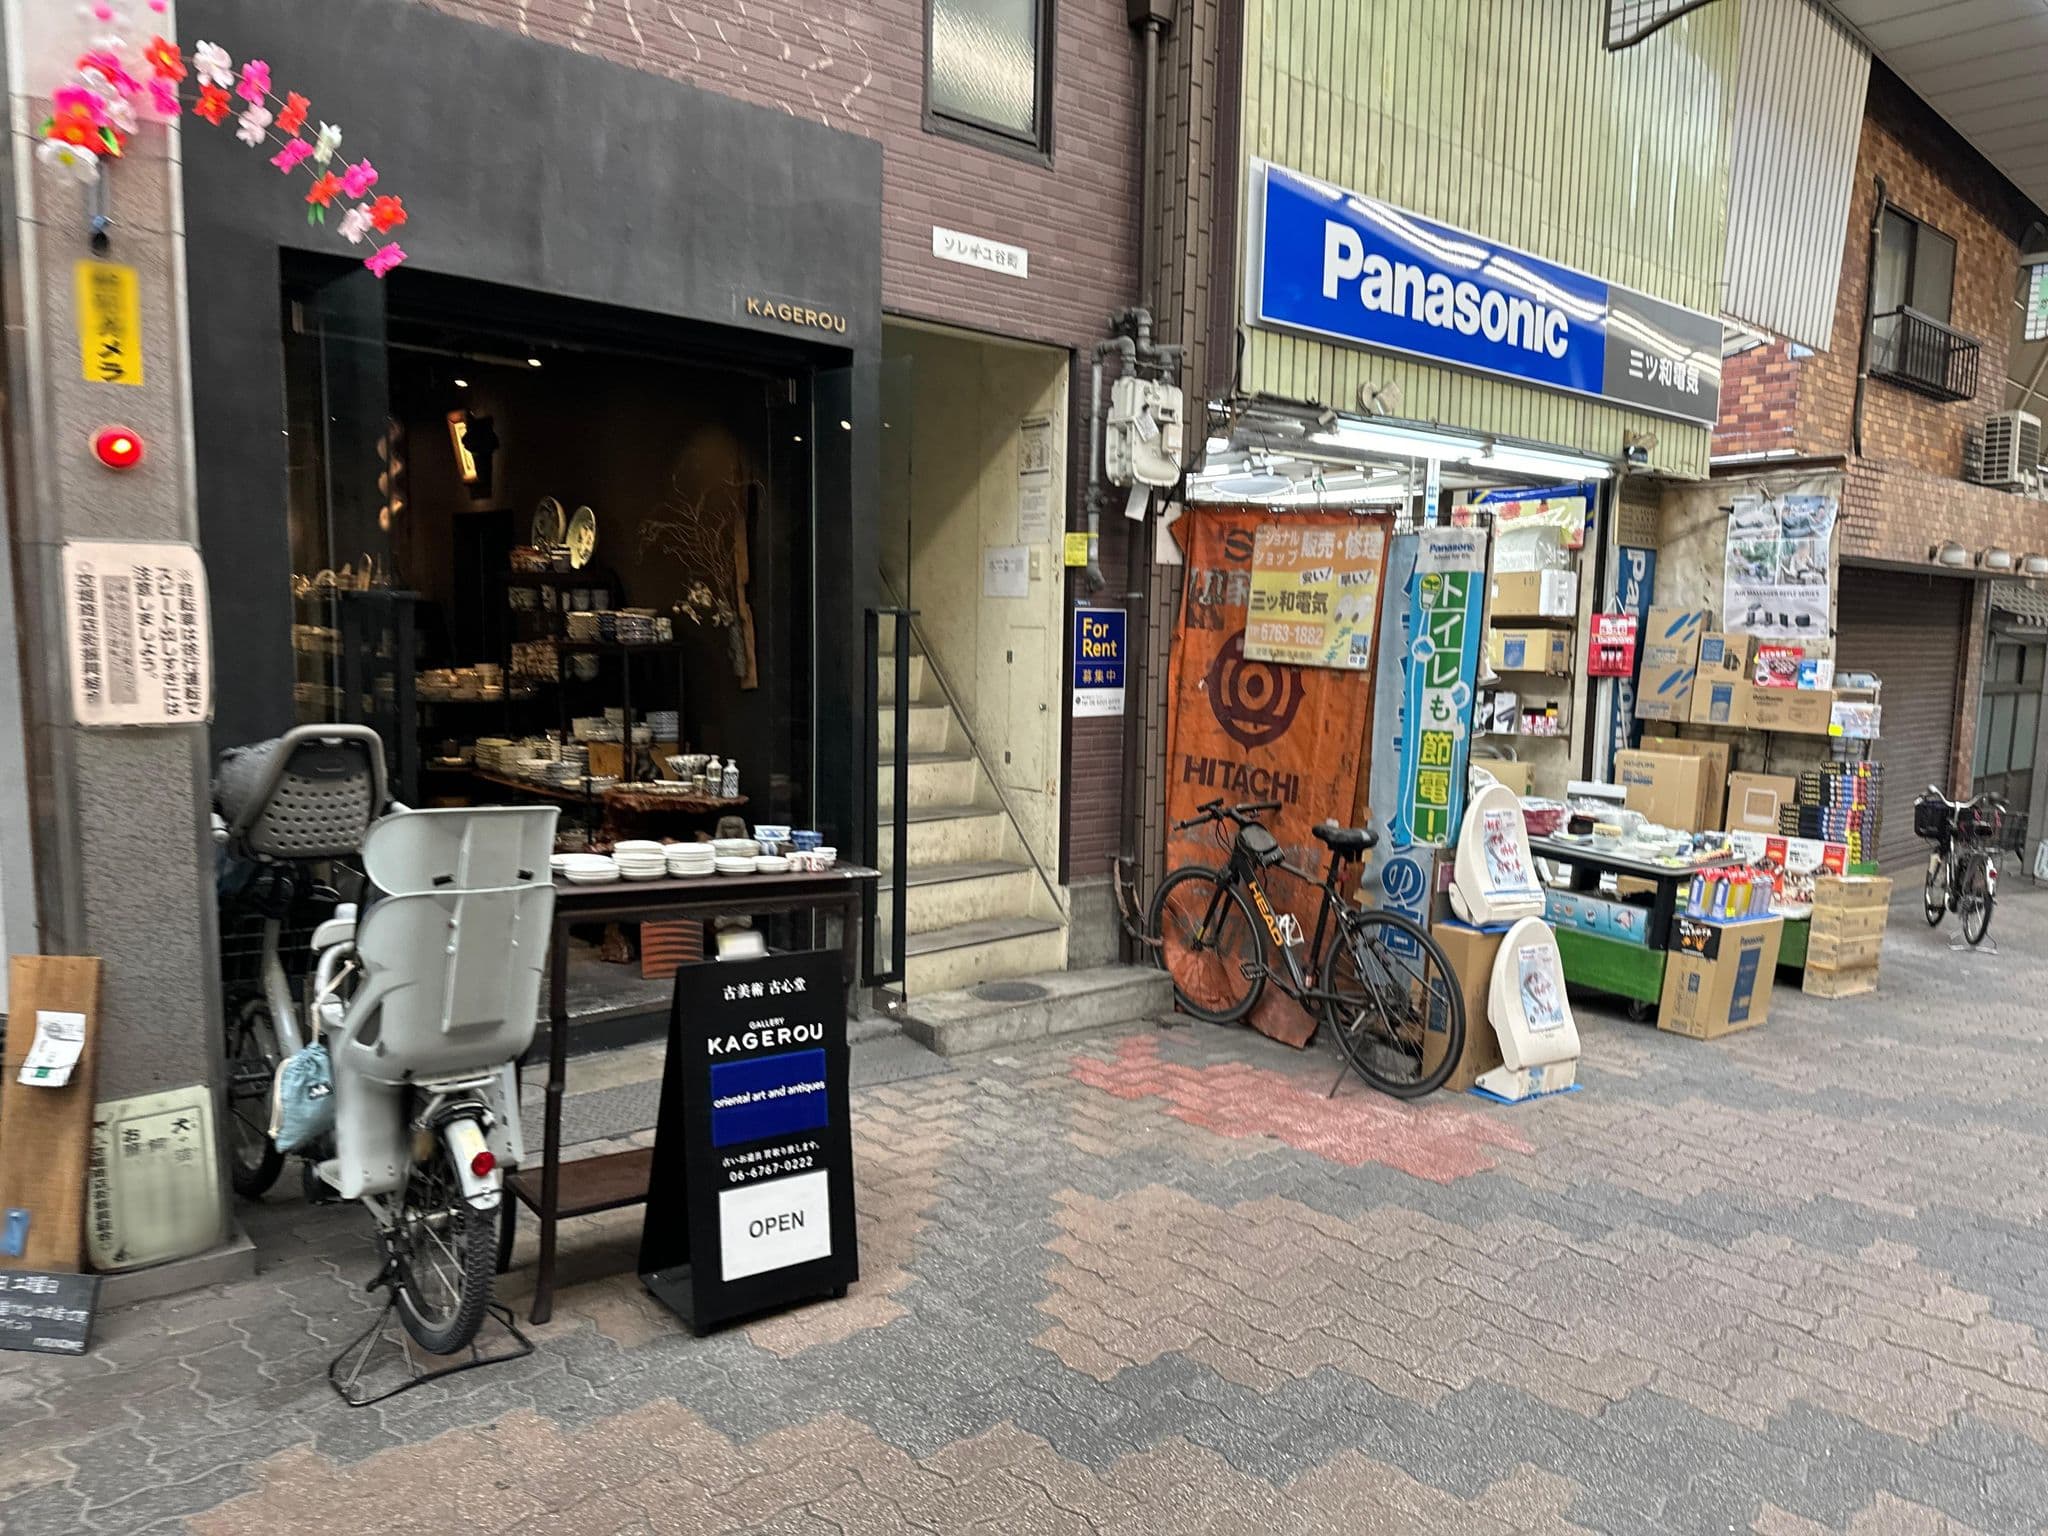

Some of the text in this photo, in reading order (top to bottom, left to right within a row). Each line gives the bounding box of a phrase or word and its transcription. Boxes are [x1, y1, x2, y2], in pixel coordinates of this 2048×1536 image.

[1322, 218, 1569, 359] Panasonic
[746, 296, 847, 334] KAGEROU
[1628, 349, 1700, 396] 三ツ和電気
[1083, 617, 1109, 639] For
[1082, 638, 1118, 657] Rent
[1183, 754, 1299, 805] HITACHI
[1249, 881, 1283, 947] HEAD
[707, 1022, 824, 1056] KAGEROU
[748, 1016, 785, 1031] GALLERY
[713, 1092, 751, 1109] oriental
[752, 1090, 766, 1102] art
[767, 1085, 786, 1100] and
[729, 1155, 813, 1183] 06-6767-0222
[749, 1209, 806, 1238] OPEN
